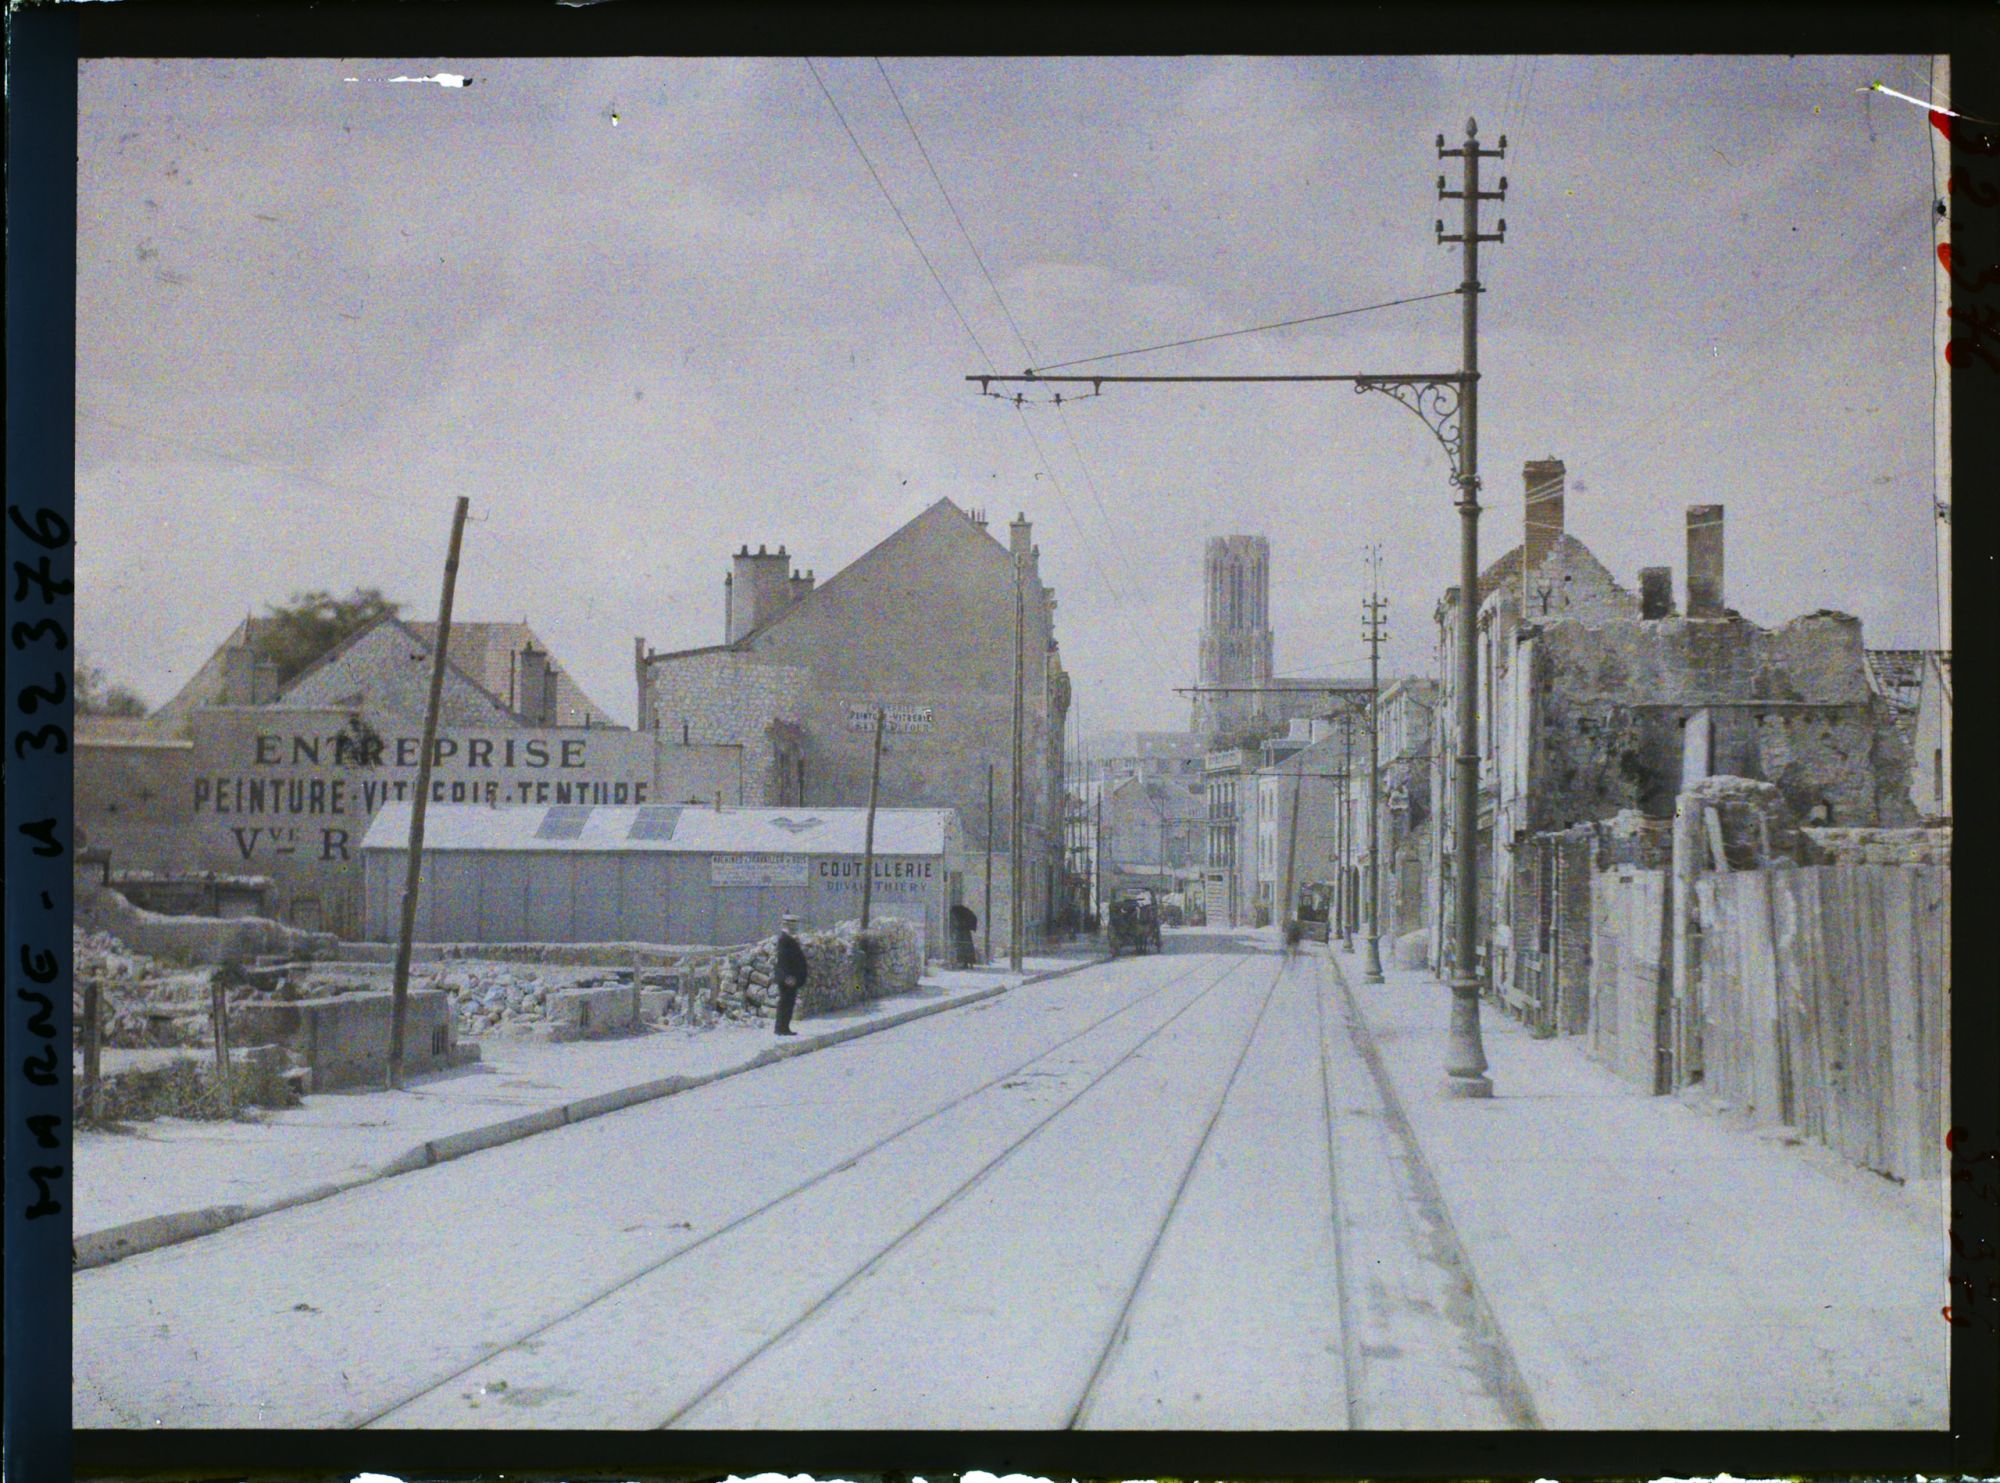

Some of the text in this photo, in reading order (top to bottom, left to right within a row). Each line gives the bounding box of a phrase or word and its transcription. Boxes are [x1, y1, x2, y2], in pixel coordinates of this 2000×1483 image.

[255, 735, 587, 768] ENTREPRISE
[820, 862, 932, 877] COUTLLERIE
[19, 944, 61, 1219] MARNE
